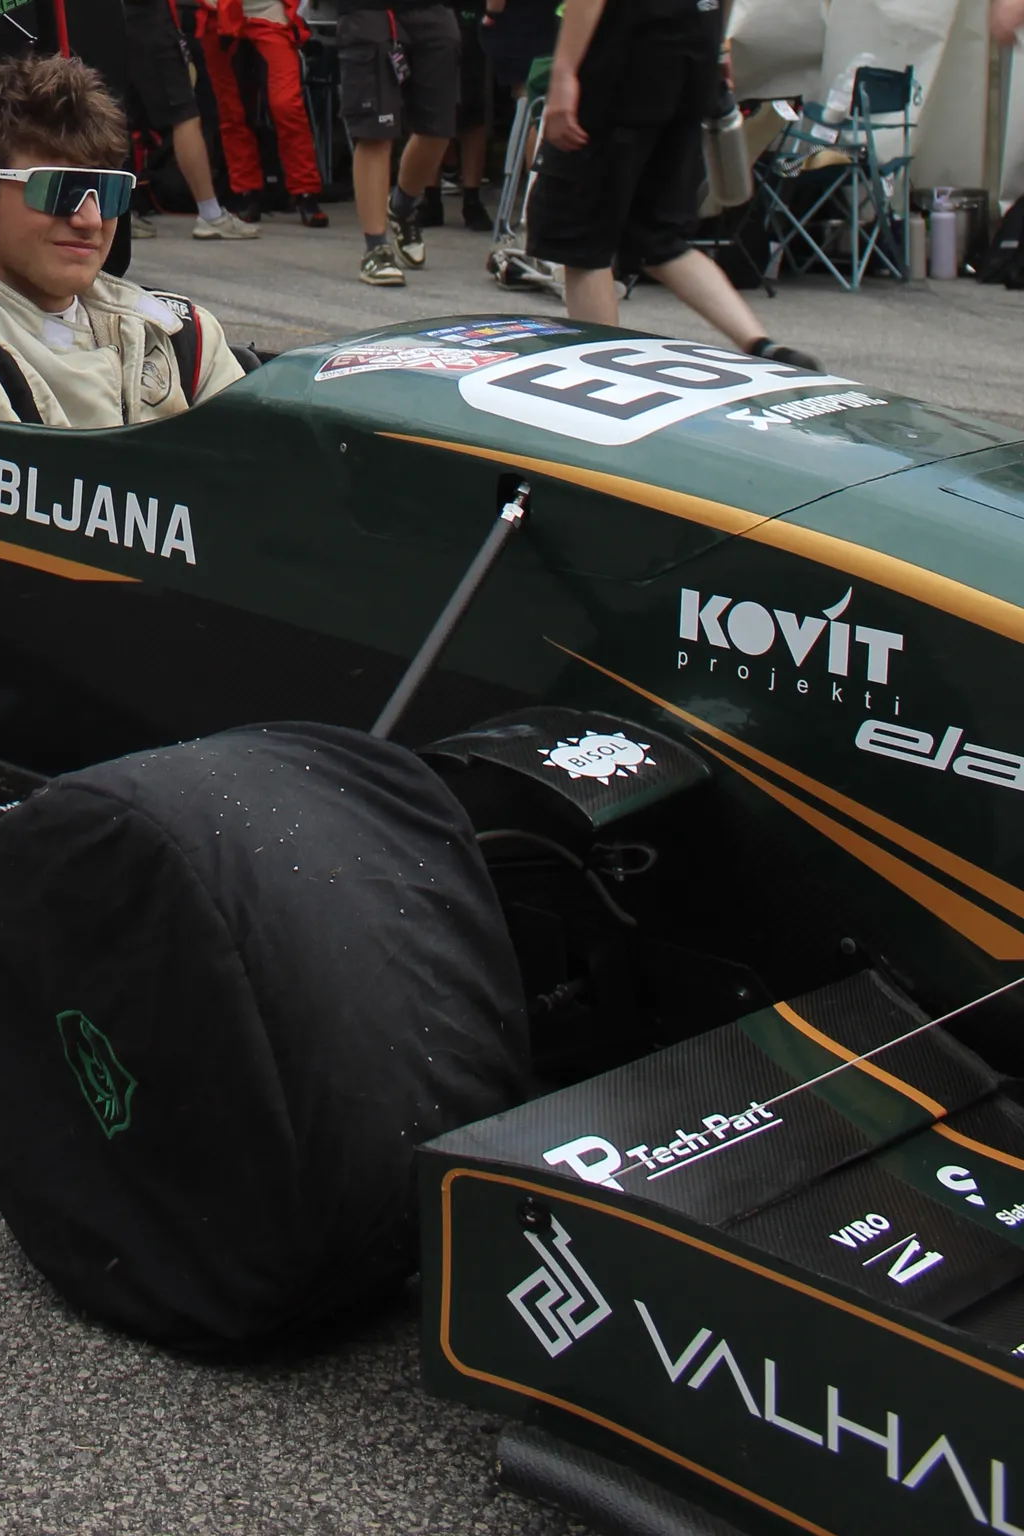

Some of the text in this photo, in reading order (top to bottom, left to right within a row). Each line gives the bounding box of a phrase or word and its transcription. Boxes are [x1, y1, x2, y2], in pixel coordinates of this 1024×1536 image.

[677, 649, 901, 716] projekti
[567, 740, 630, 769] BISOL
[625, 1101, 774, 1170] Tech Part
[828, 1213, 891, 1249] VIRO
